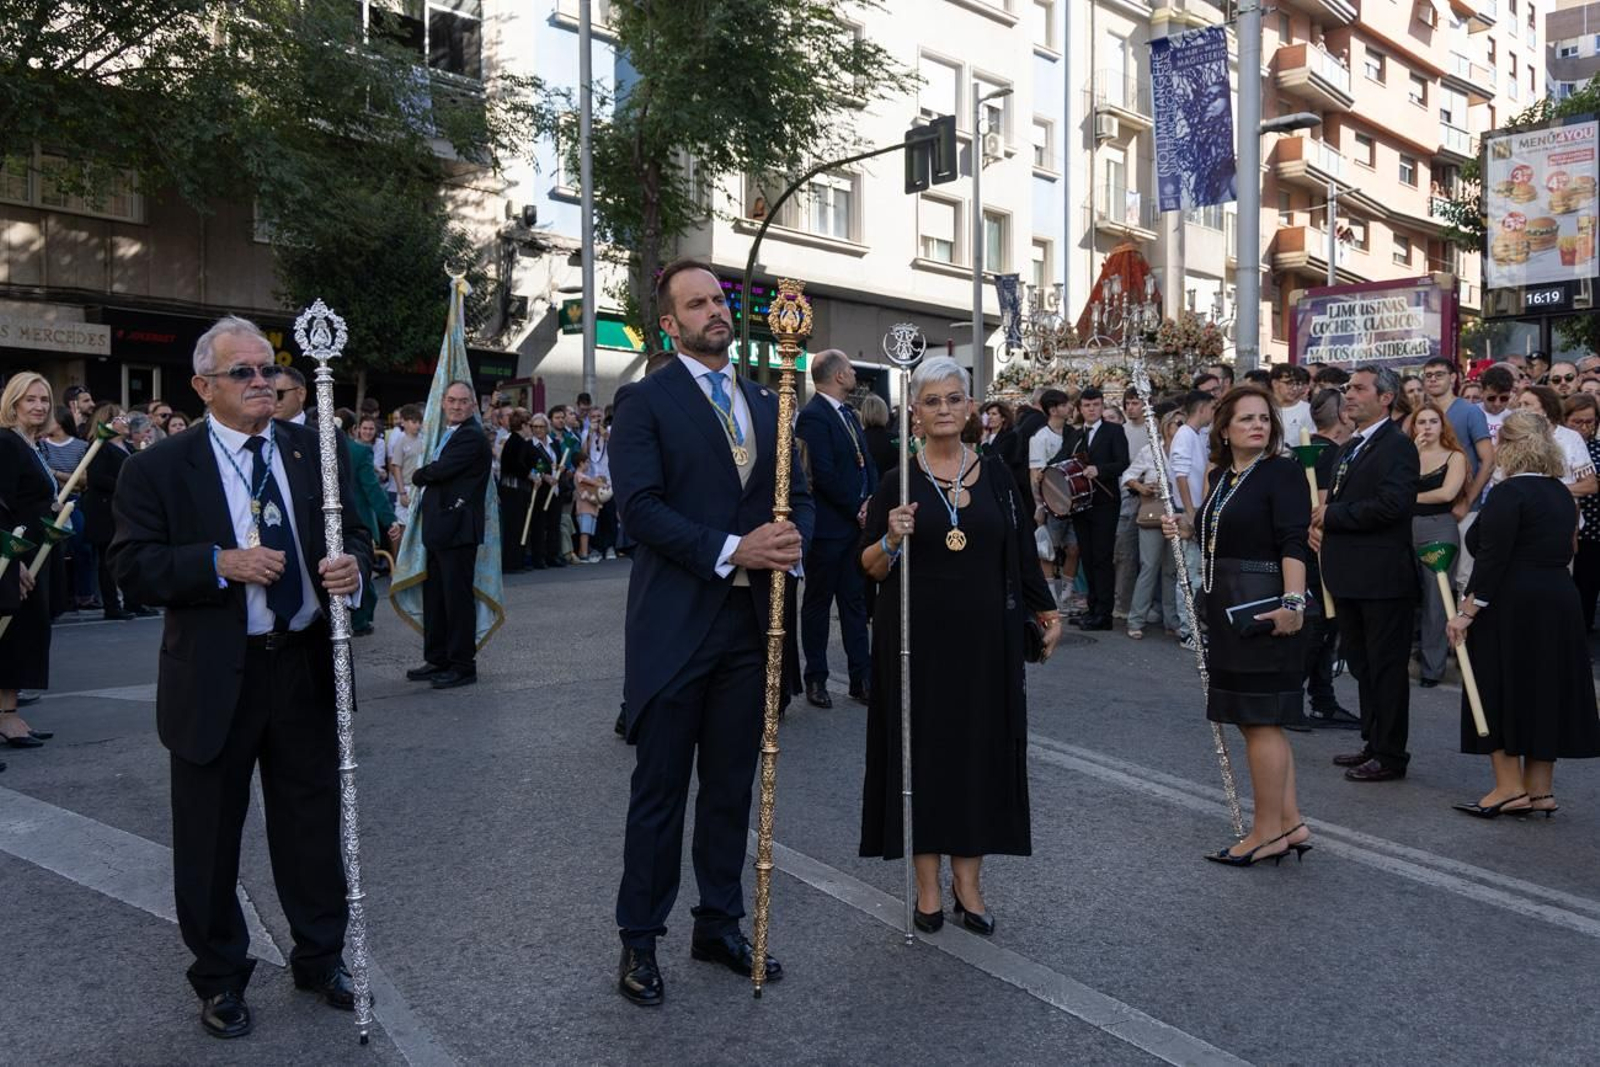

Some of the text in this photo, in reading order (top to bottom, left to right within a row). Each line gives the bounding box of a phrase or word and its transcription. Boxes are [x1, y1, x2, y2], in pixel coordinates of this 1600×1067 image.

[1177, 49, 1227, 67] MAGISTERIO
[1163, 51, 1173, 86] CASAS
[1165, 87, 1178, 149] FRANCISCO
[1526, 290, 1560, 305] 16:19
[19, 326, 107, 347] MERCEDES
[1312, 319, 1361, 336] COCHES
